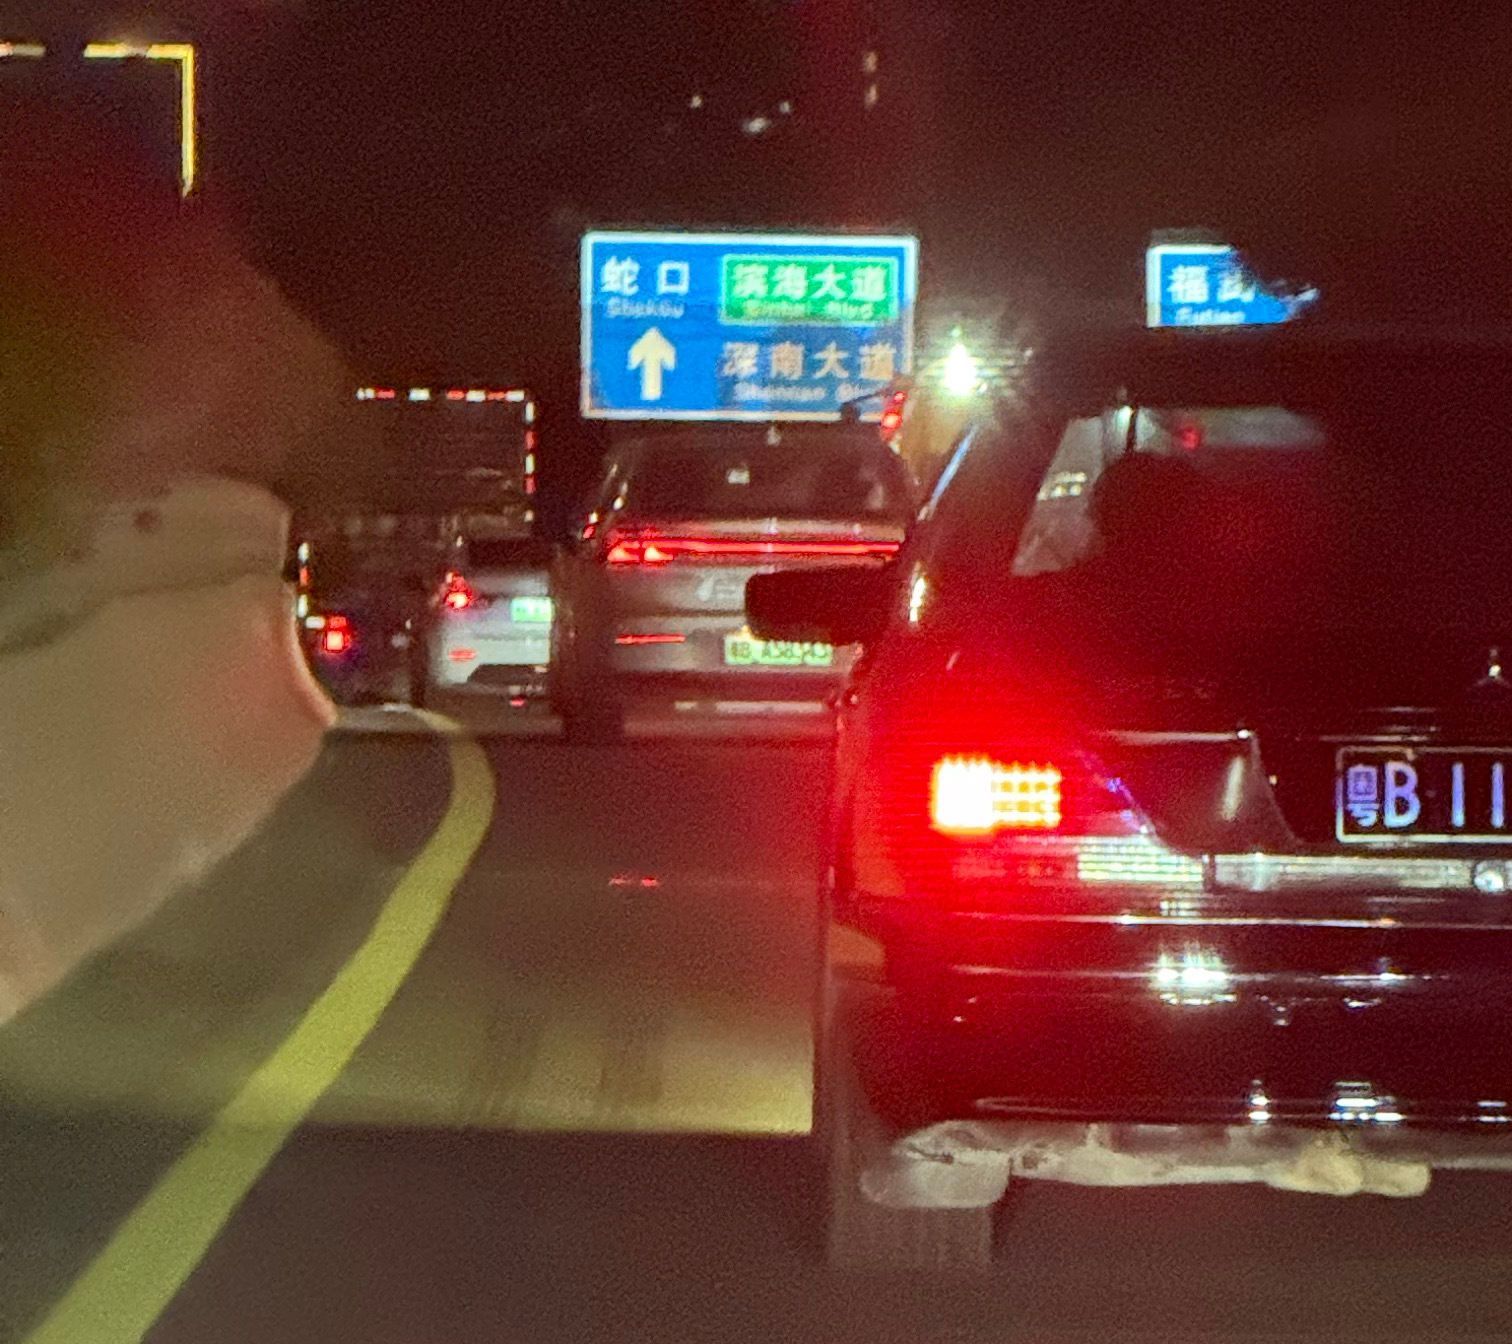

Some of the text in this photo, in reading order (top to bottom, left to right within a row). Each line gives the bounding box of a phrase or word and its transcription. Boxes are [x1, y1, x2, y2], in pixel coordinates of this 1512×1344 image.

[600, 255, 690, 296] 蛇口
[732, 262, 888, 301] 滨海大道
